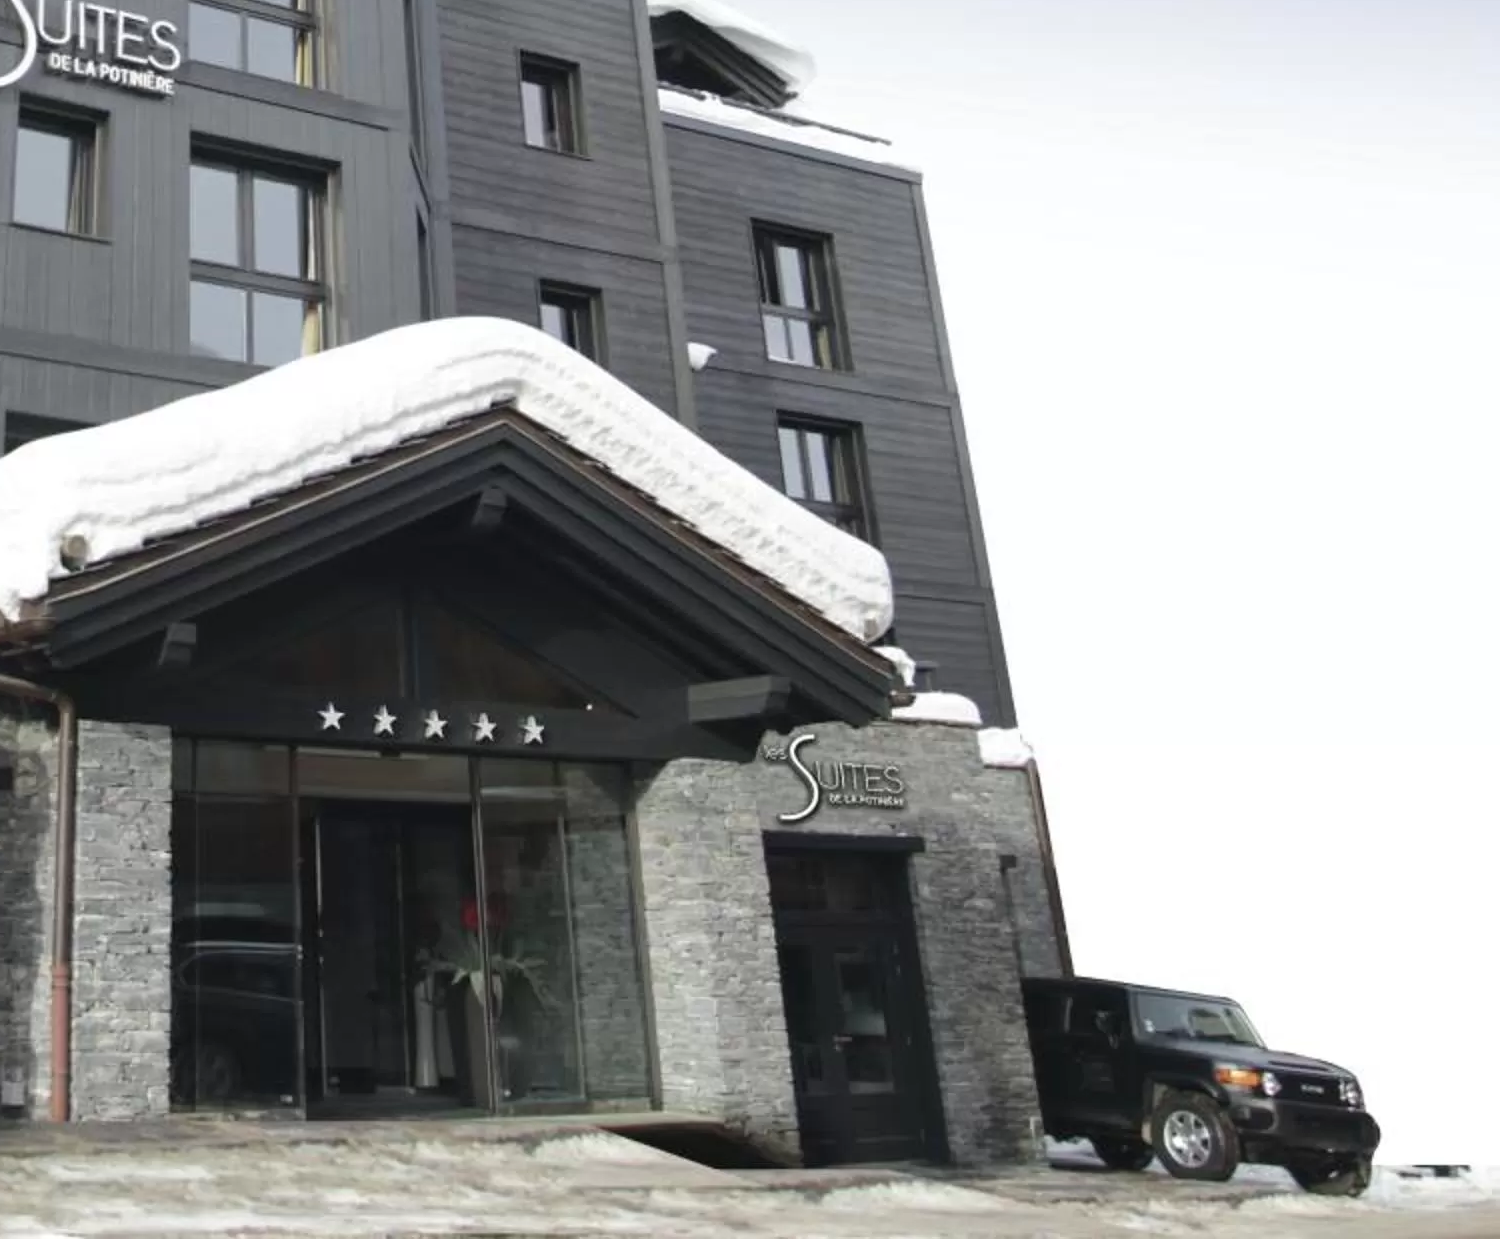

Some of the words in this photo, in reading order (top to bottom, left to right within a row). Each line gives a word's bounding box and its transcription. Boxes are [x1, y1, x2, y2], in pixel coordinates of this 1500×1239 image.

[49, 52, 72, 72] DE
[74, 57, 97, 77] LA
[779, 734, 904, 821] SUITES
